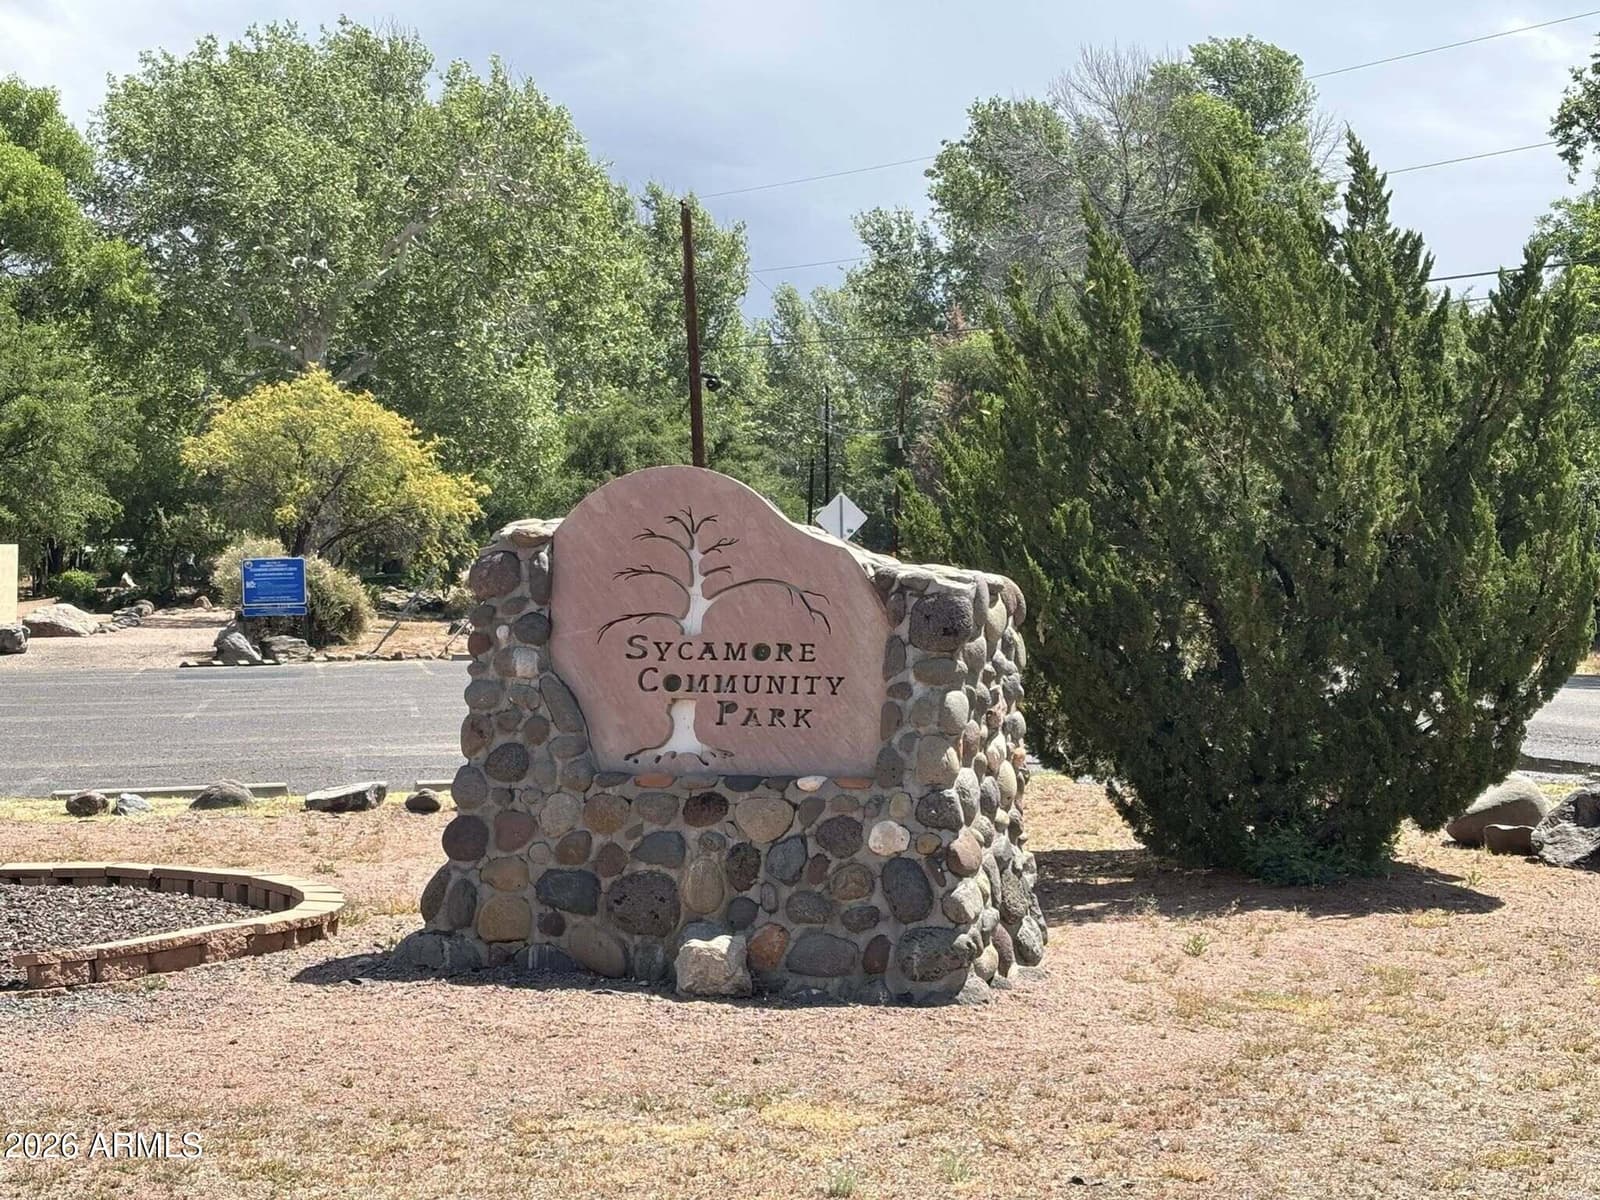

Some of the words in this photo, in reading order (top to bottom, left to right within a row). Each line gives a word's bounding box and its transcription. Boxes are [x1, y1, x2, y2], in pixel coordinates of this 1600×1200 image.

[625, 634, 817, 662] SYCAMORE
[638, 667, 845, 695] COMMUNITY
[715, 700, 813, 728] PARK
